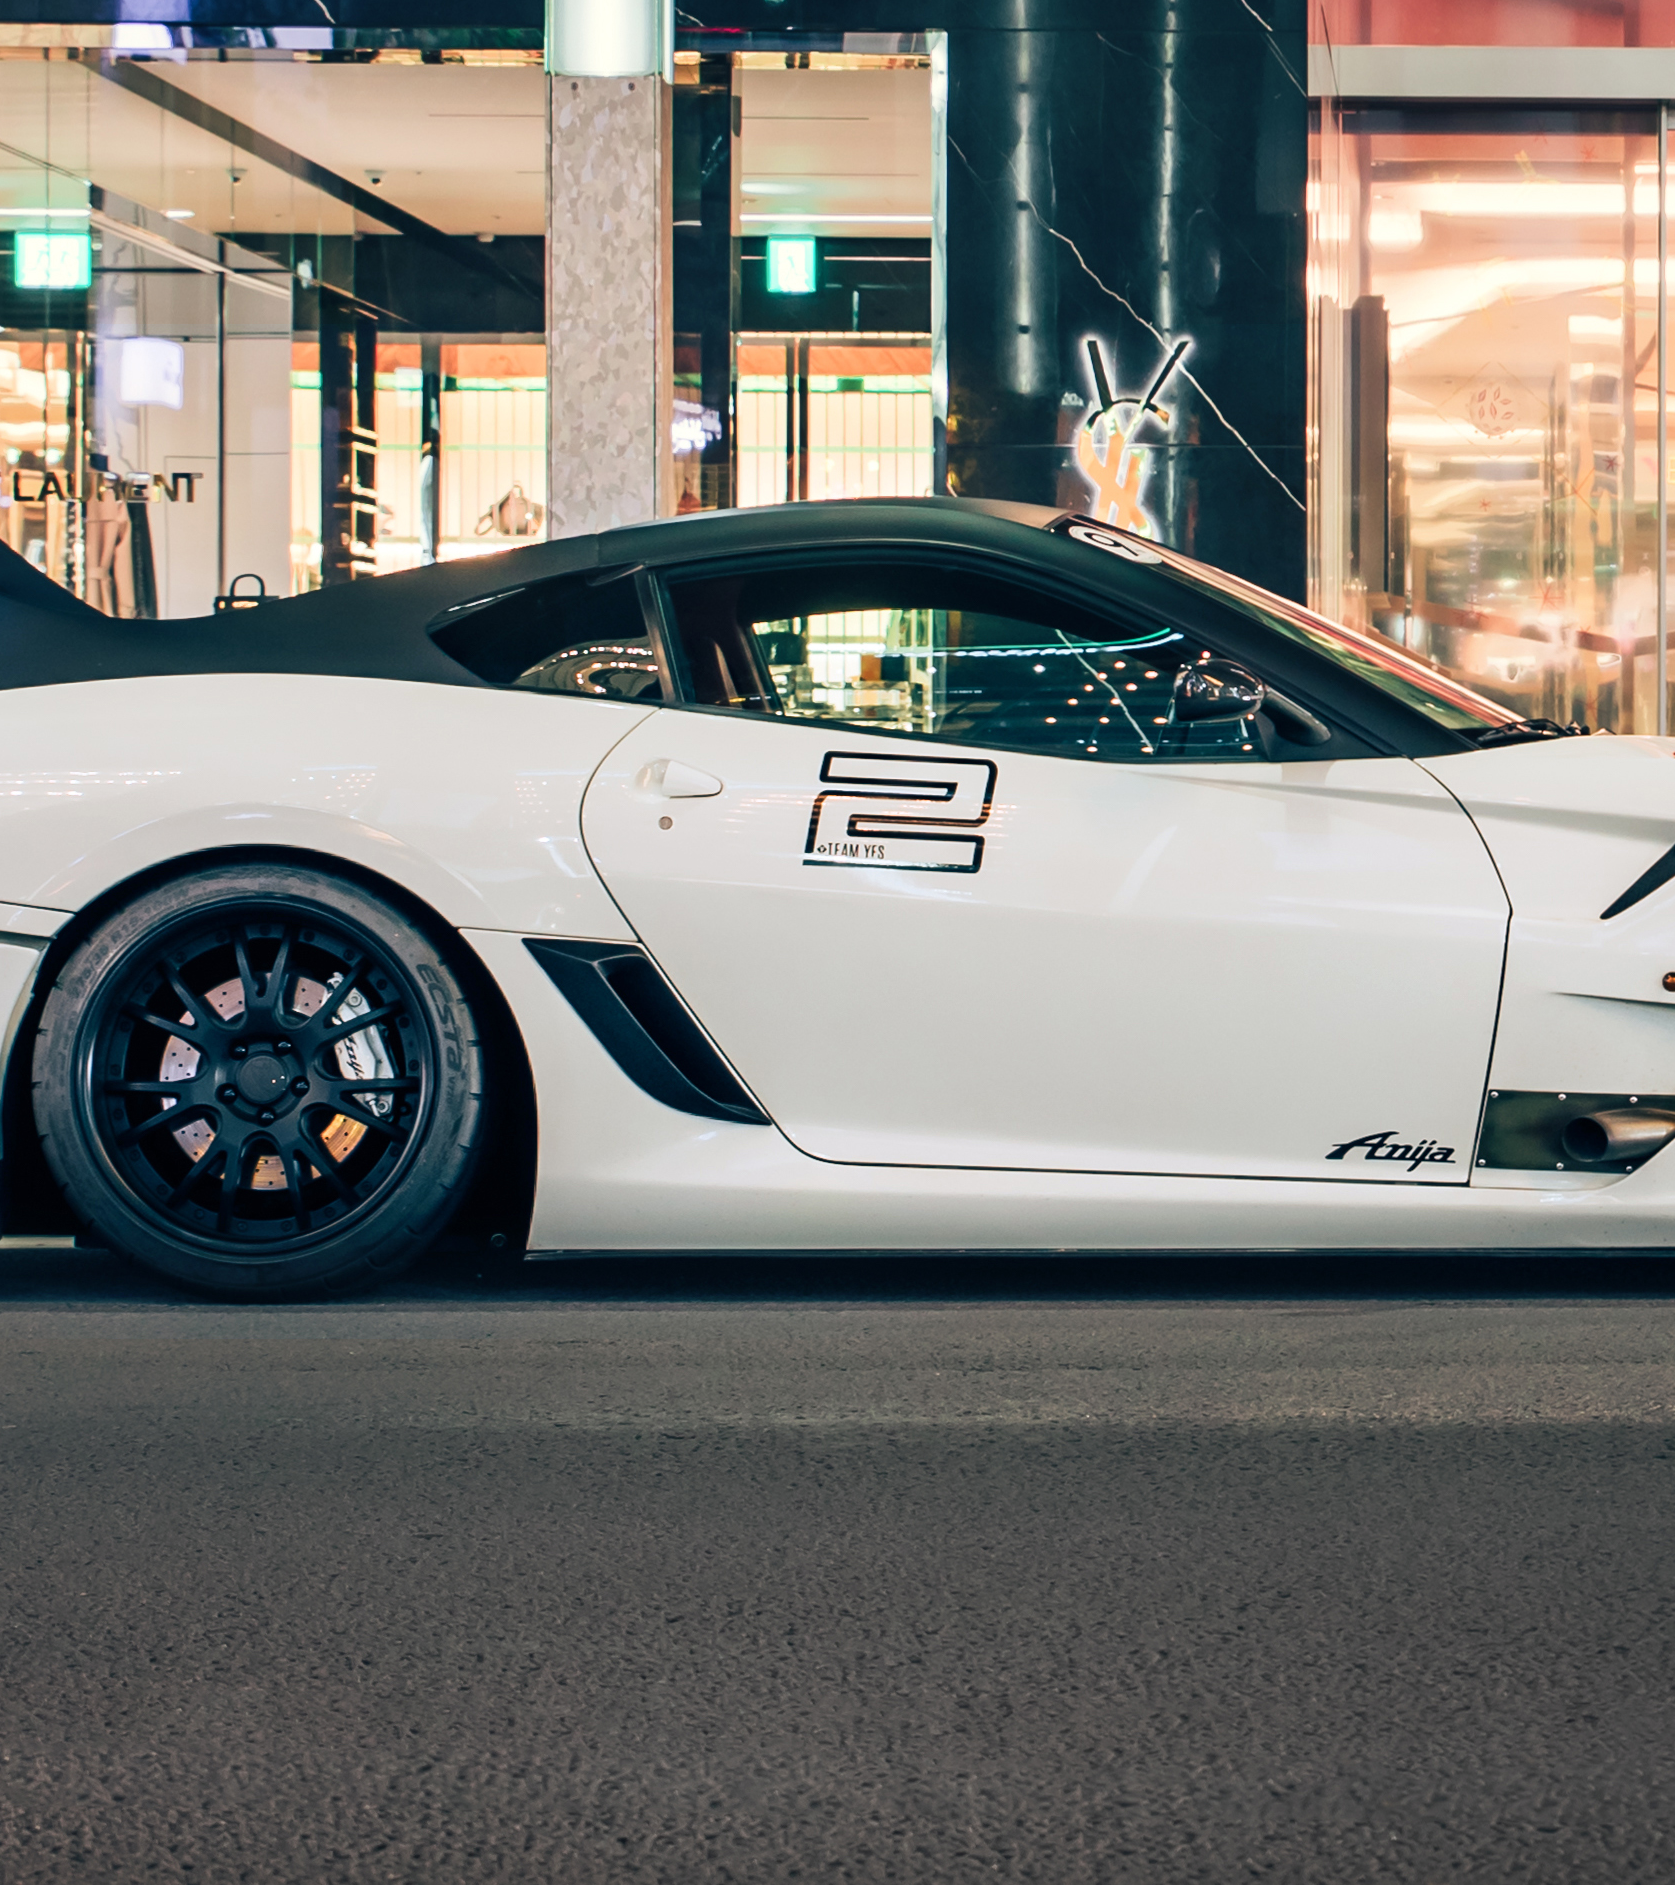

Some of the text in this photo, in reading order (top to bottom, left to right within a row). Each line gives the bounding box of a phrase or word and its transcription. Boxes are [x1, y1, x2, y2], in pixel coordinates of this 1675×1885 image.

[13, 470, 204, 503] LAURENT
[802, 750, 999, 874] 2
[1324, 1130, 1457, 1173] Anija
